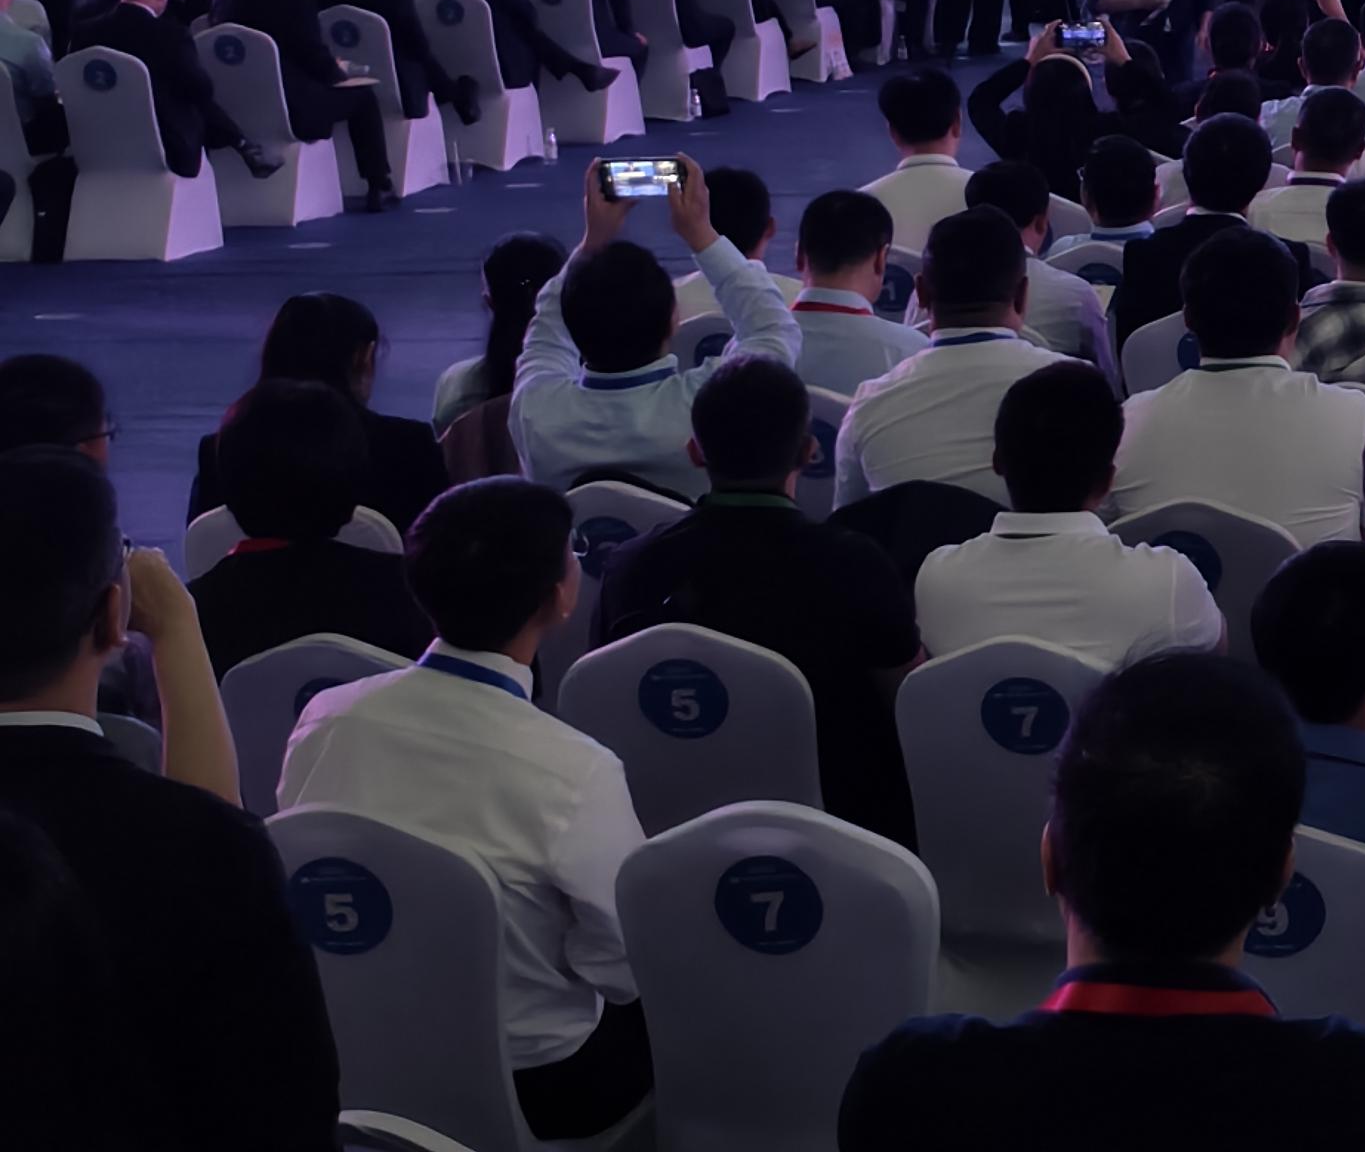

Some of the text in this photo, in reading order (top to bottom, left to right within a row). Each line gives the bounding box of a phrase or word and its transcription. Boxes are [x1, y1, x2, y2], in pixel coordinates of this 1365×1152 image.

[670, 688, 702, 722] 5
[1010, 705, 1040, 738] 7
[323, 892, 360, 933] 5
[749, 890, 787, 934] 7
